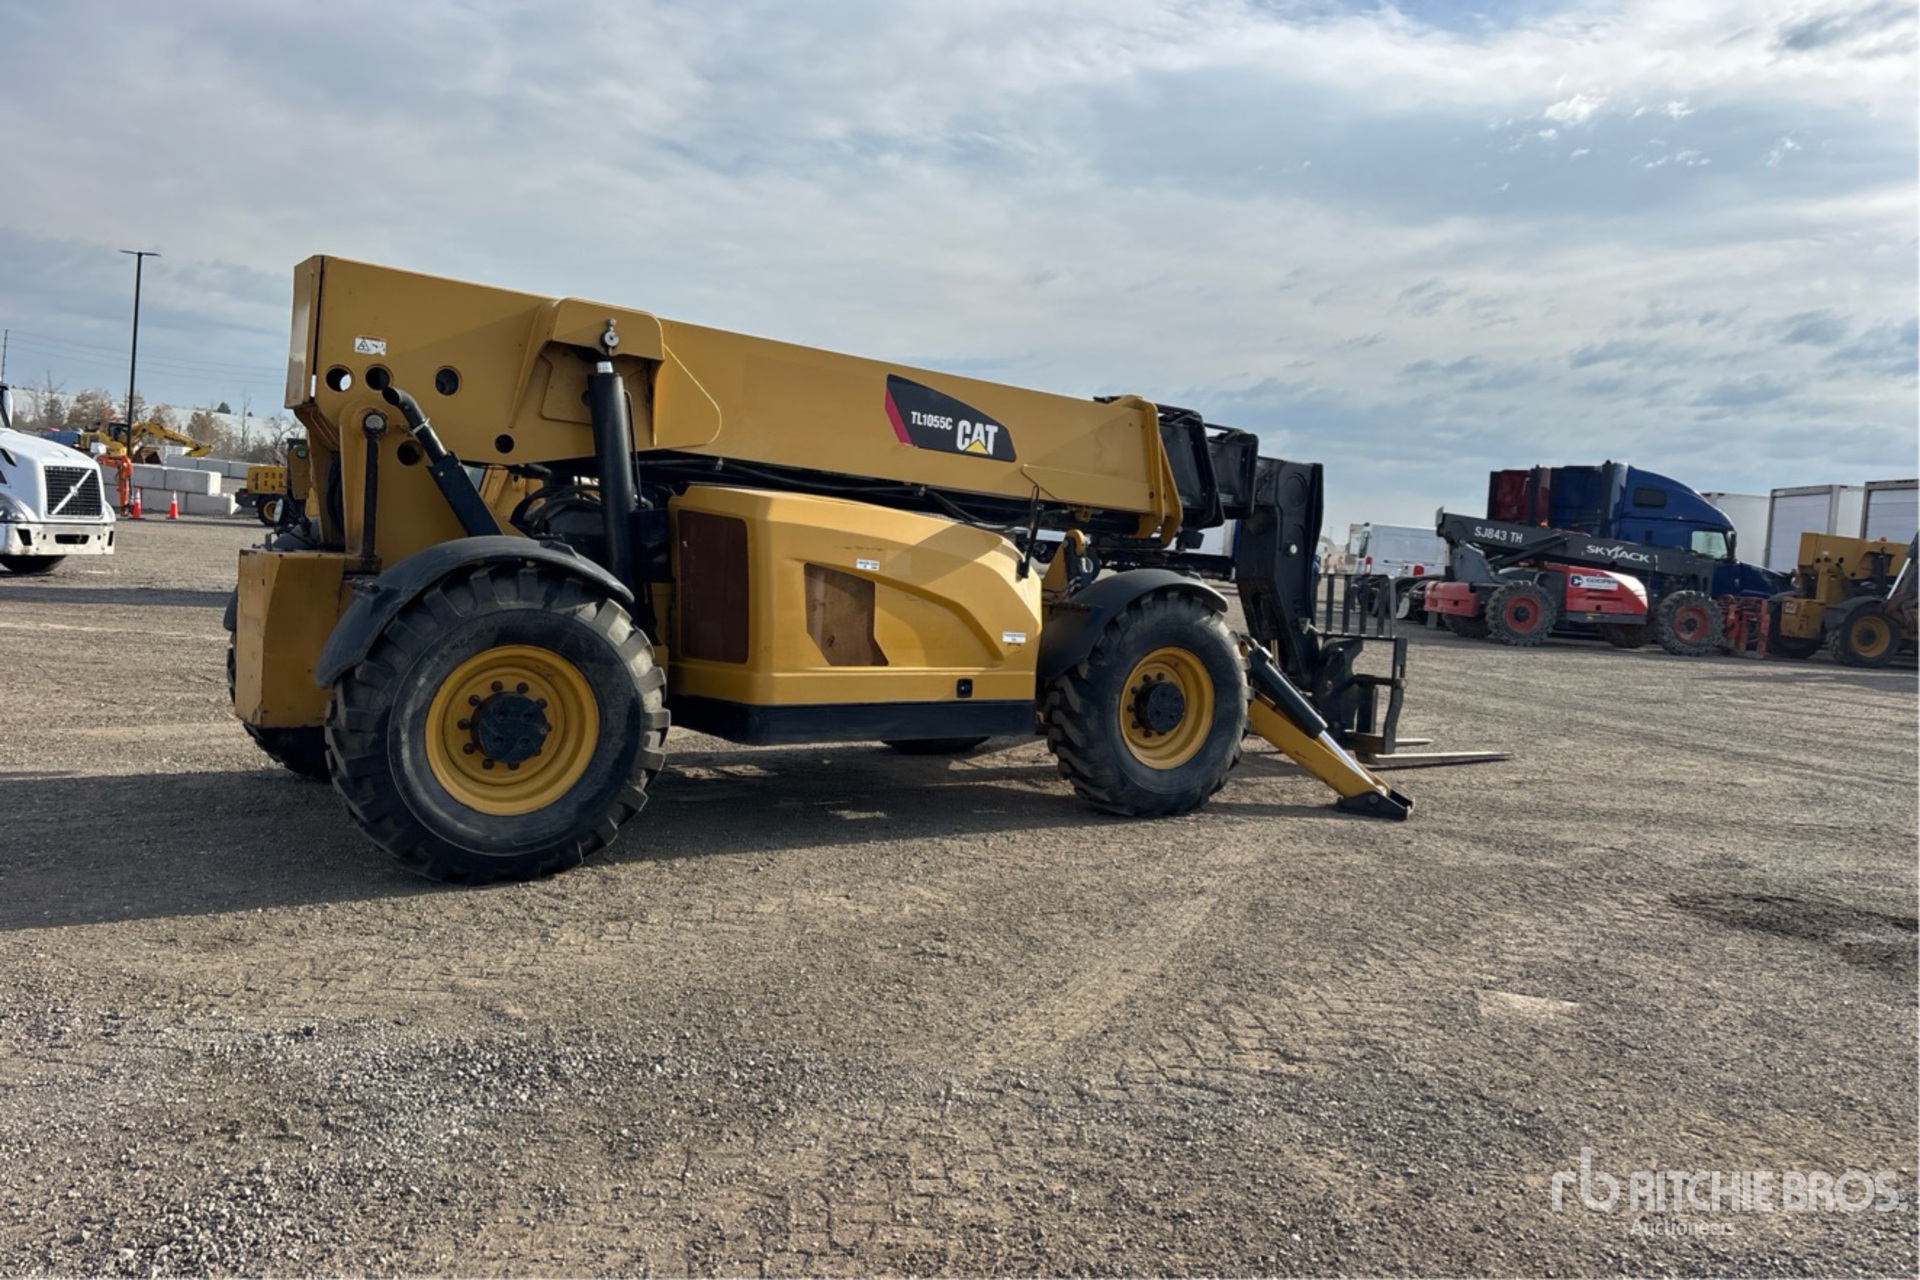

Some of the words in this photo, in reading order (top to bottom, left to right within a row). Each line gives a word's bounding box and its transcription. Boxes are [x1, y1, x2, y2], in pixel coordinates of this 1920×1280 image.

[911, 411, 953, 431] TL1055C
[956, 419, 999, 455] CAT
[1474, 526, 1507, 542] SJ843
[1510, 532, 1523, 543] TH
[1586, 545, 1650, 563] SKYJACK
